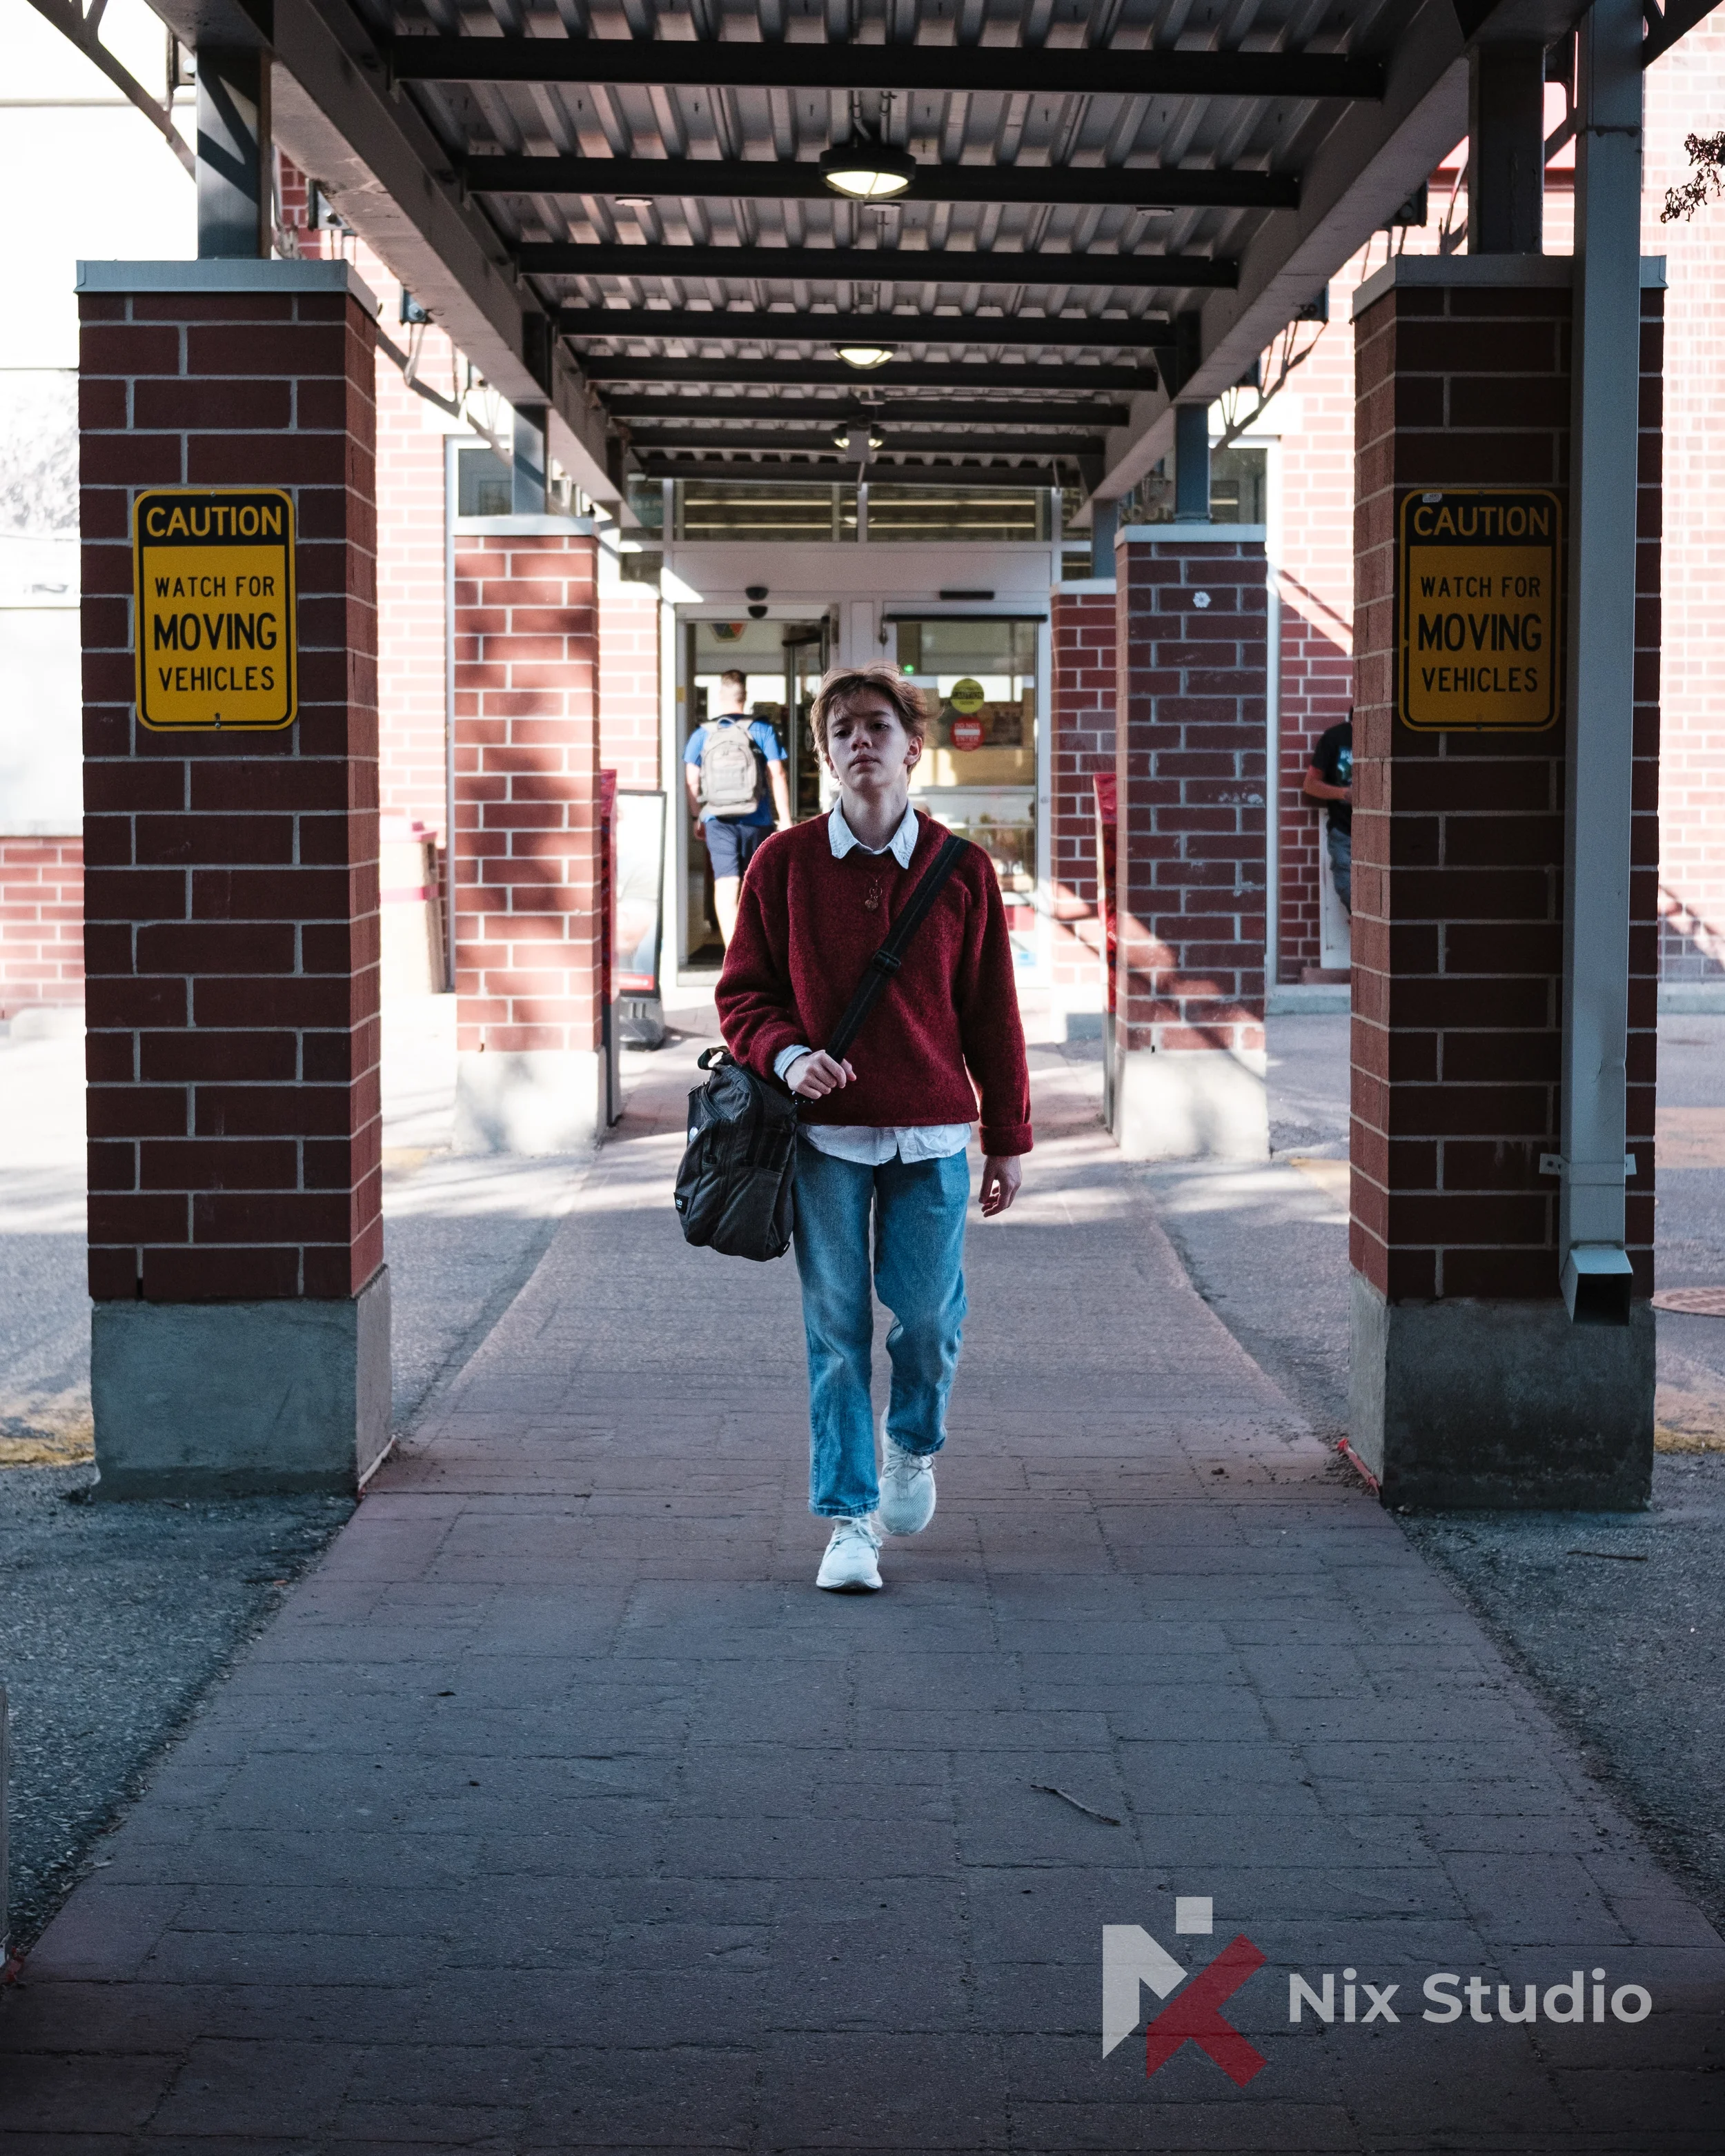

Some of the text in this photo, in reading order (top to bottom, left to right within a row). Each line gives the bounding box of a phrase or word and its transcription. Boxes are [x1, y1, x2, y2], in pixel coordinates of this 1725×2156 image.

[147, 507, 281, 537] CAUTION
[1414, 506, 1548, 535] CAUTION
[155, 576, 274, 597] WATCH FOR
[1421, 576, 1541, 597] WATCH FOR
[155, 613, 276, 651] MOVING
[1419, 613, 1542, 652] MOVING
[159, 666, 274, 691] VEHICLES
[1422, 666, 1538, 692] VEHICLES
